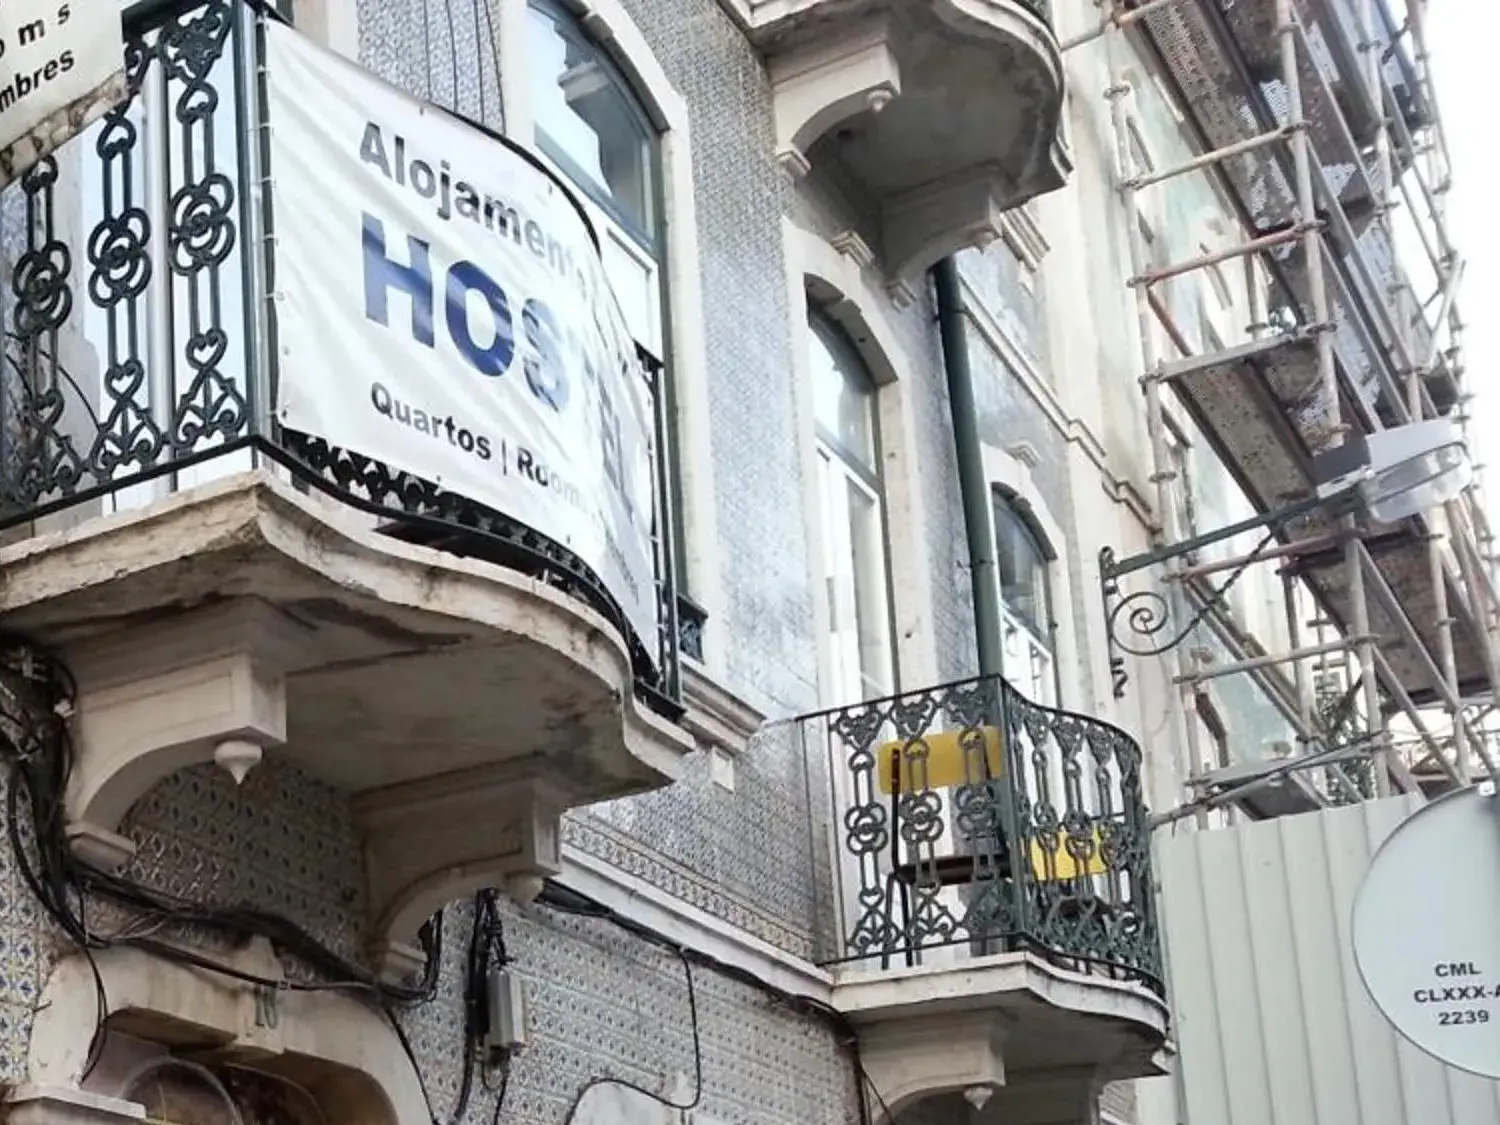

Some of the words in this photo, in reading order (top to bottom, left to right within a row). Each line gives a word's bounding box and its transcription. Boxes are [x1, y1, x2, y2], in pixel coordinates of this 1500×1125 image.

[371, 380, 492, 463] Quartos
[1435, 962, 1482, 977] CML
[1438, 1009, 1489, 1026] 2239
